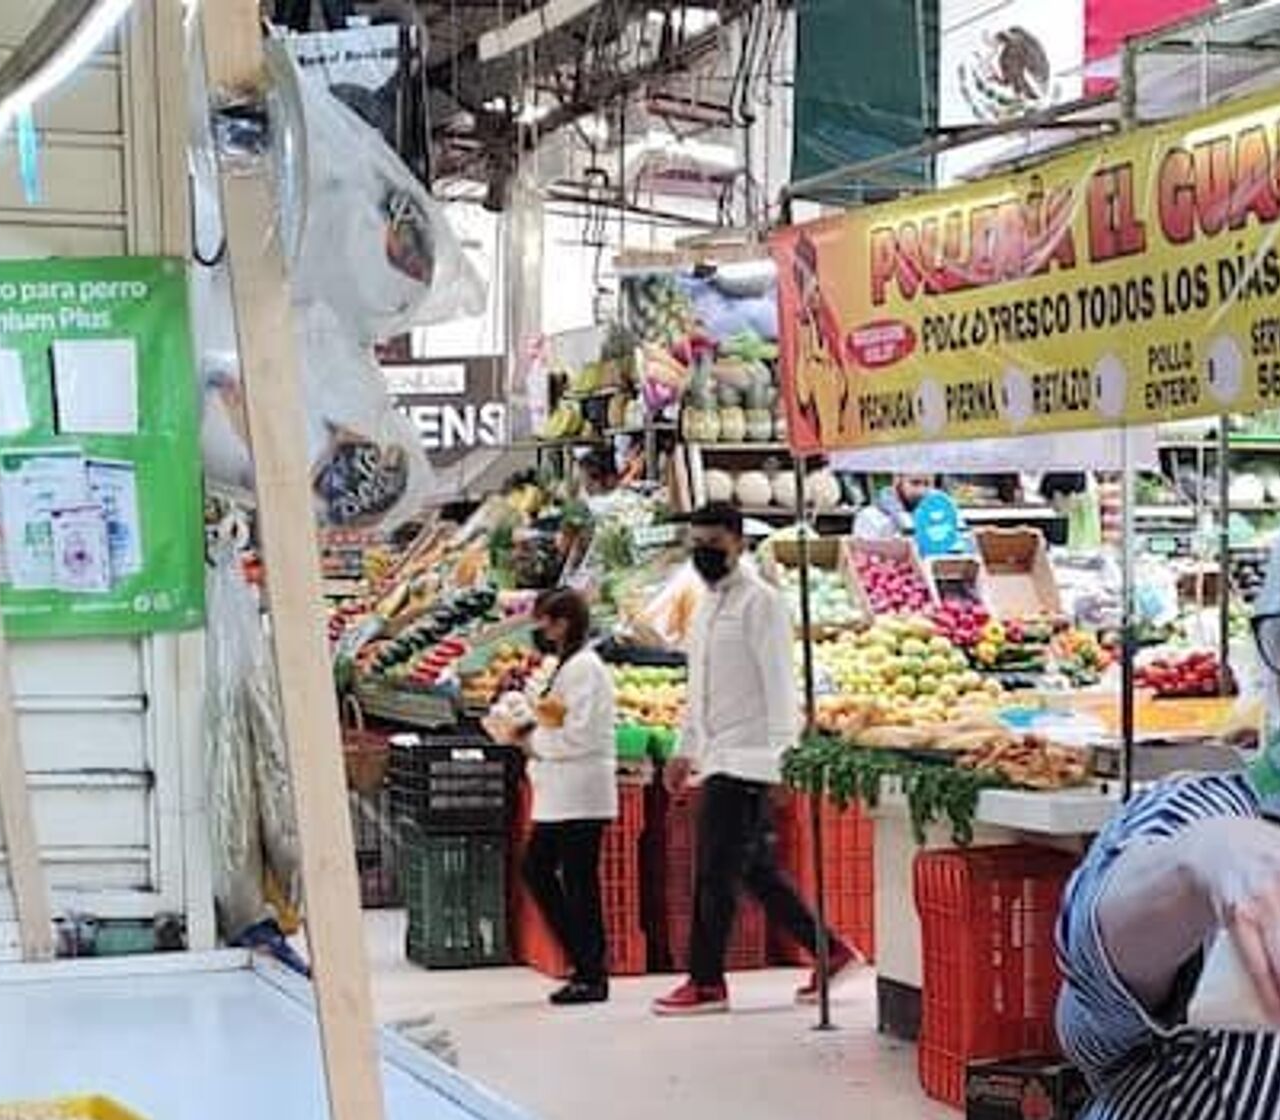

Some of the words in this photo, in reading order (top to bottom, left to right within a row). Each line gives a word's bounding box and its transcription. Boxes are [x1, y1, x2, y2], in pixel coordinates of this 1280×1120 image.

[1087, 162, 1147, 264] EL
[21, 279, 76, 304] para
[79, 279, 148, 303] perro
[923, 308, 988, 355] POLLO
[989, 293, 1071, 345] FRESCO
[1078, 275, 1155, 331] TODOS
[1163, 262, 1211, 315] LOS
[1147, 339, 1193, 376] POLLO
[858, 391, 916, 432] PECHUGA
[945, 378, 999, 422] PIERNA
[1031, 367, 1092, 414] RETAZO
[1144, 376, 1201, 411] ENTERO
